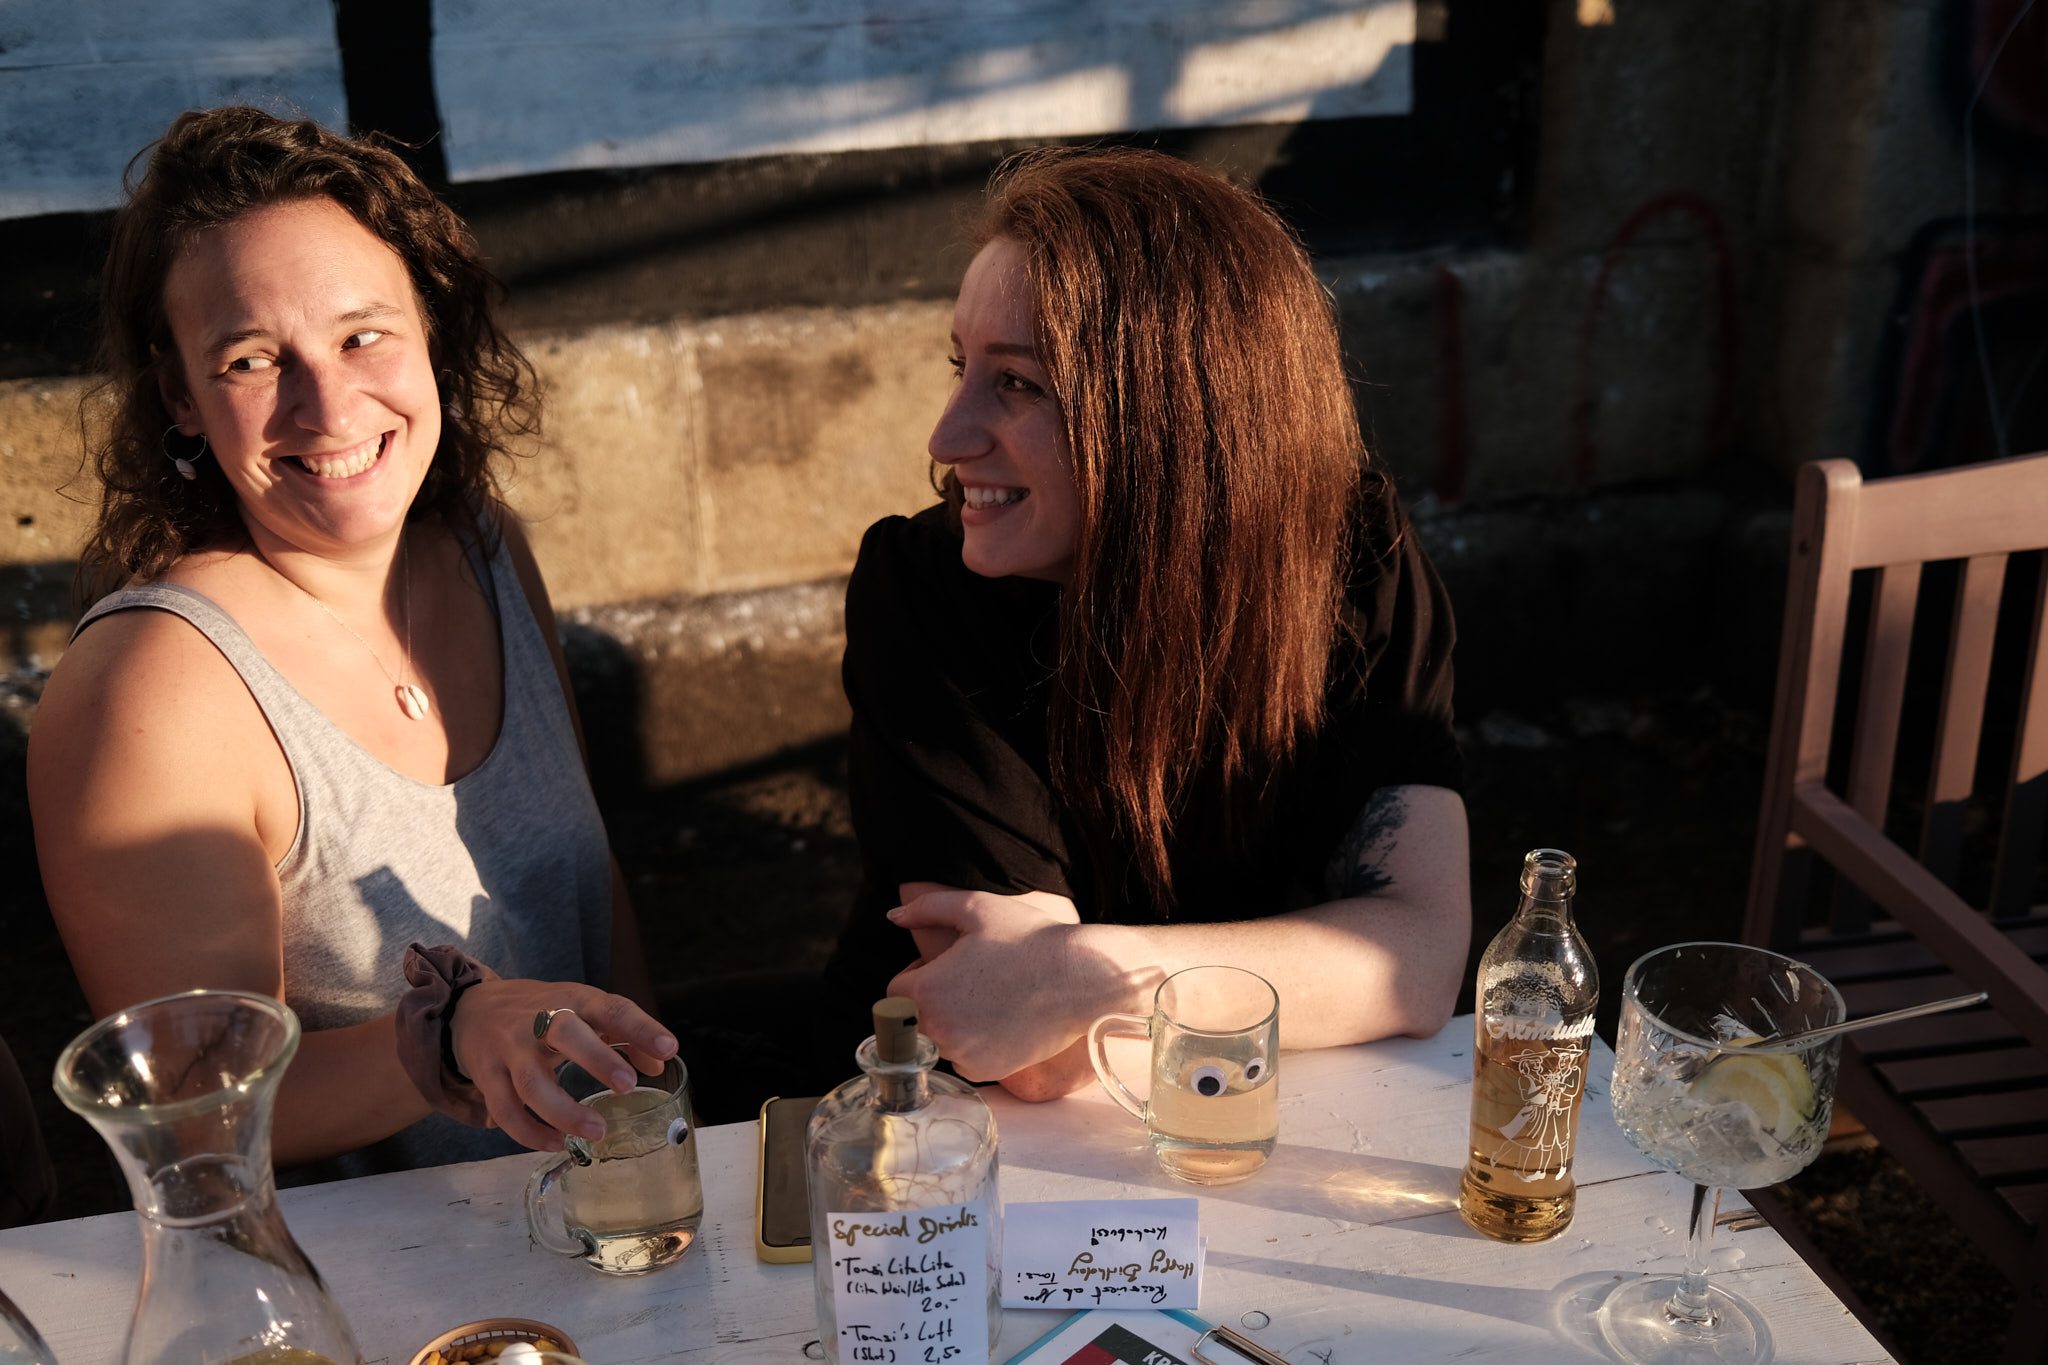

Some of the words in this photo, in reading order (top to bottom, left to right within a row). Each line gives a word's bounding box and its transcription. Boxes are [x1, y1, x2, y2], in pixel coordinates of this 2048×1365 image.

[833, 1216, 910, 1247] Special
[917, 1206, 979, 1244] Drinks
[1068, 1252, 1142, 1283] Birthday
[1149, 1249, 1195, 1280] Happy
[1062, 1287, 1085, 1302] ab
[924, 1345, 962, 1365] 2,50
